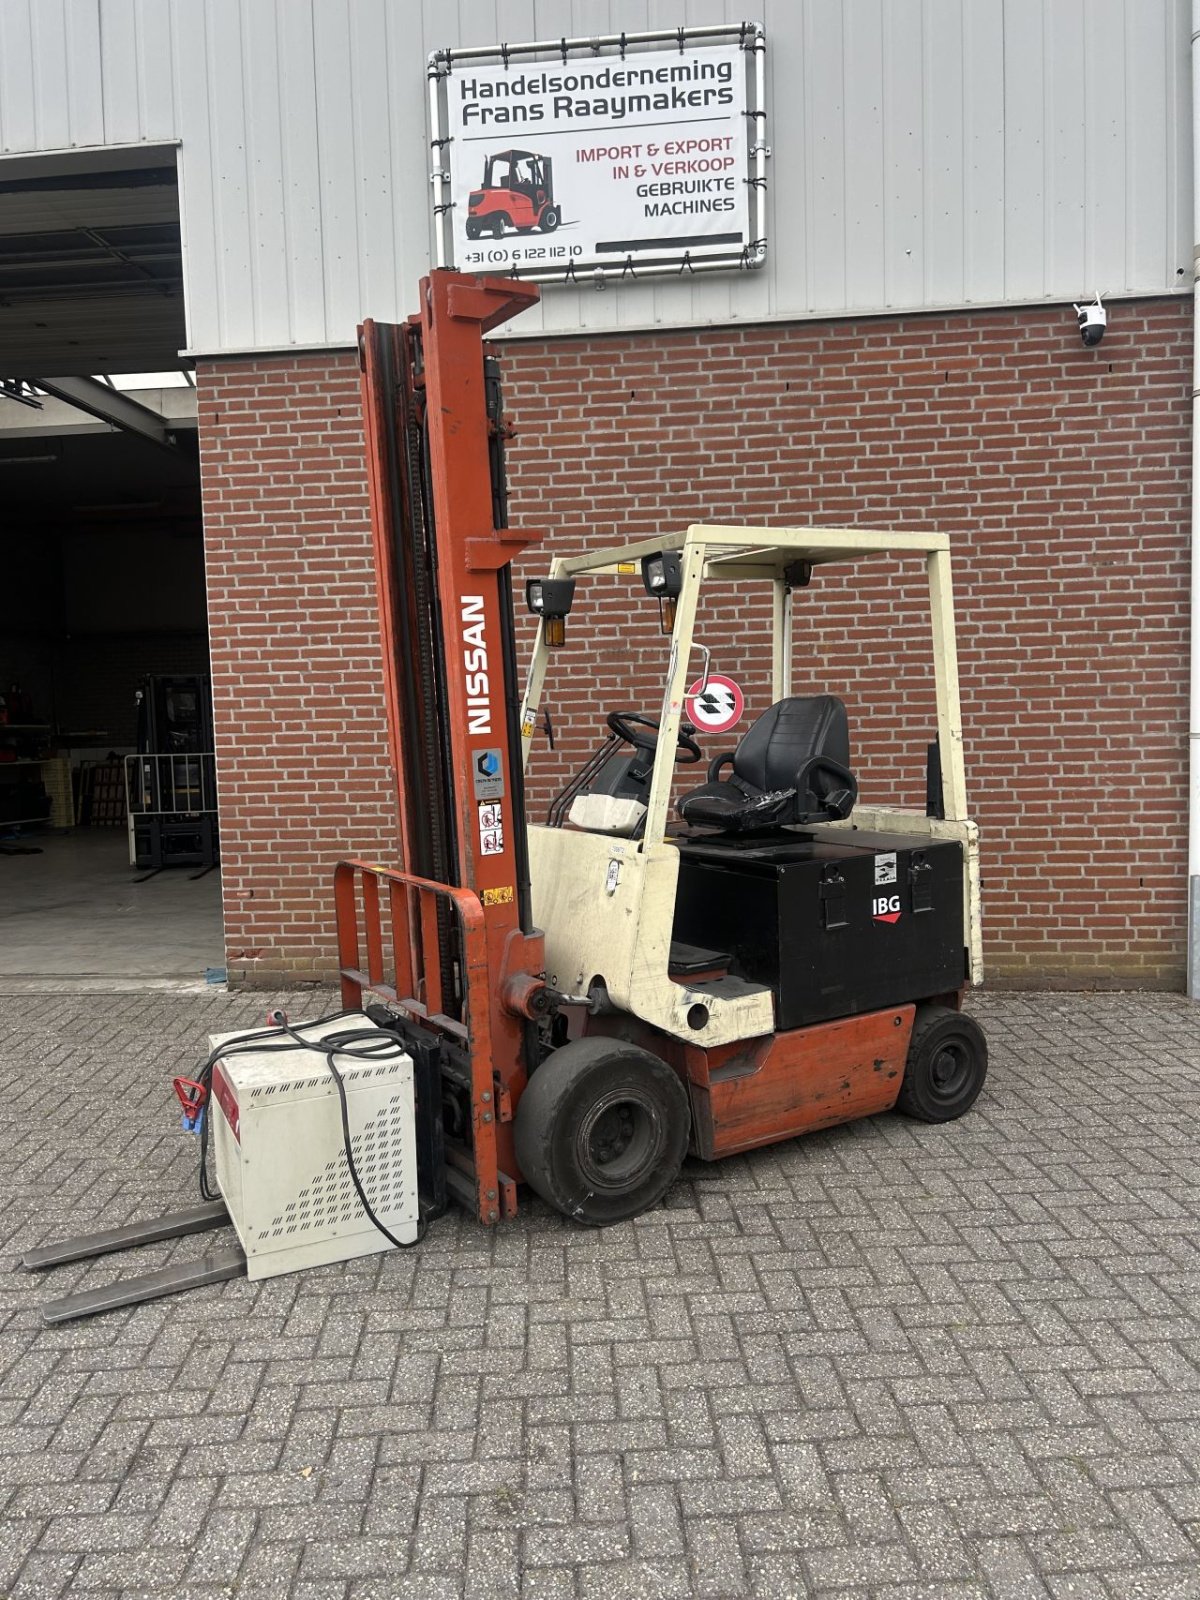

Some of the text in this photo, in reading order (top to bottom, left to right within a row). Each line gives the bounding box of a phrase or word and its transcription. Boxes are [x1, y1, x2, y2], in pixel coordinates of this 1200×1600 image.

[460, 60, 732, 100] Handelsonderneming
[462, 86, 733, 126] Frans Raaymakers
[576, 137, 733, 163] IMPORT & EXPORT
[613, 157, 735, 180] IN & VERKOOP
[636, 177, 735, 198] GEBRUIKTE
[644, 197, 735, 218] MACHINES
[465, 245, 583, 263] +31 (0) 6 122 112 10
[460, 595, 491, 734] NISSAN
[873, 895, 900, 916] IBG
